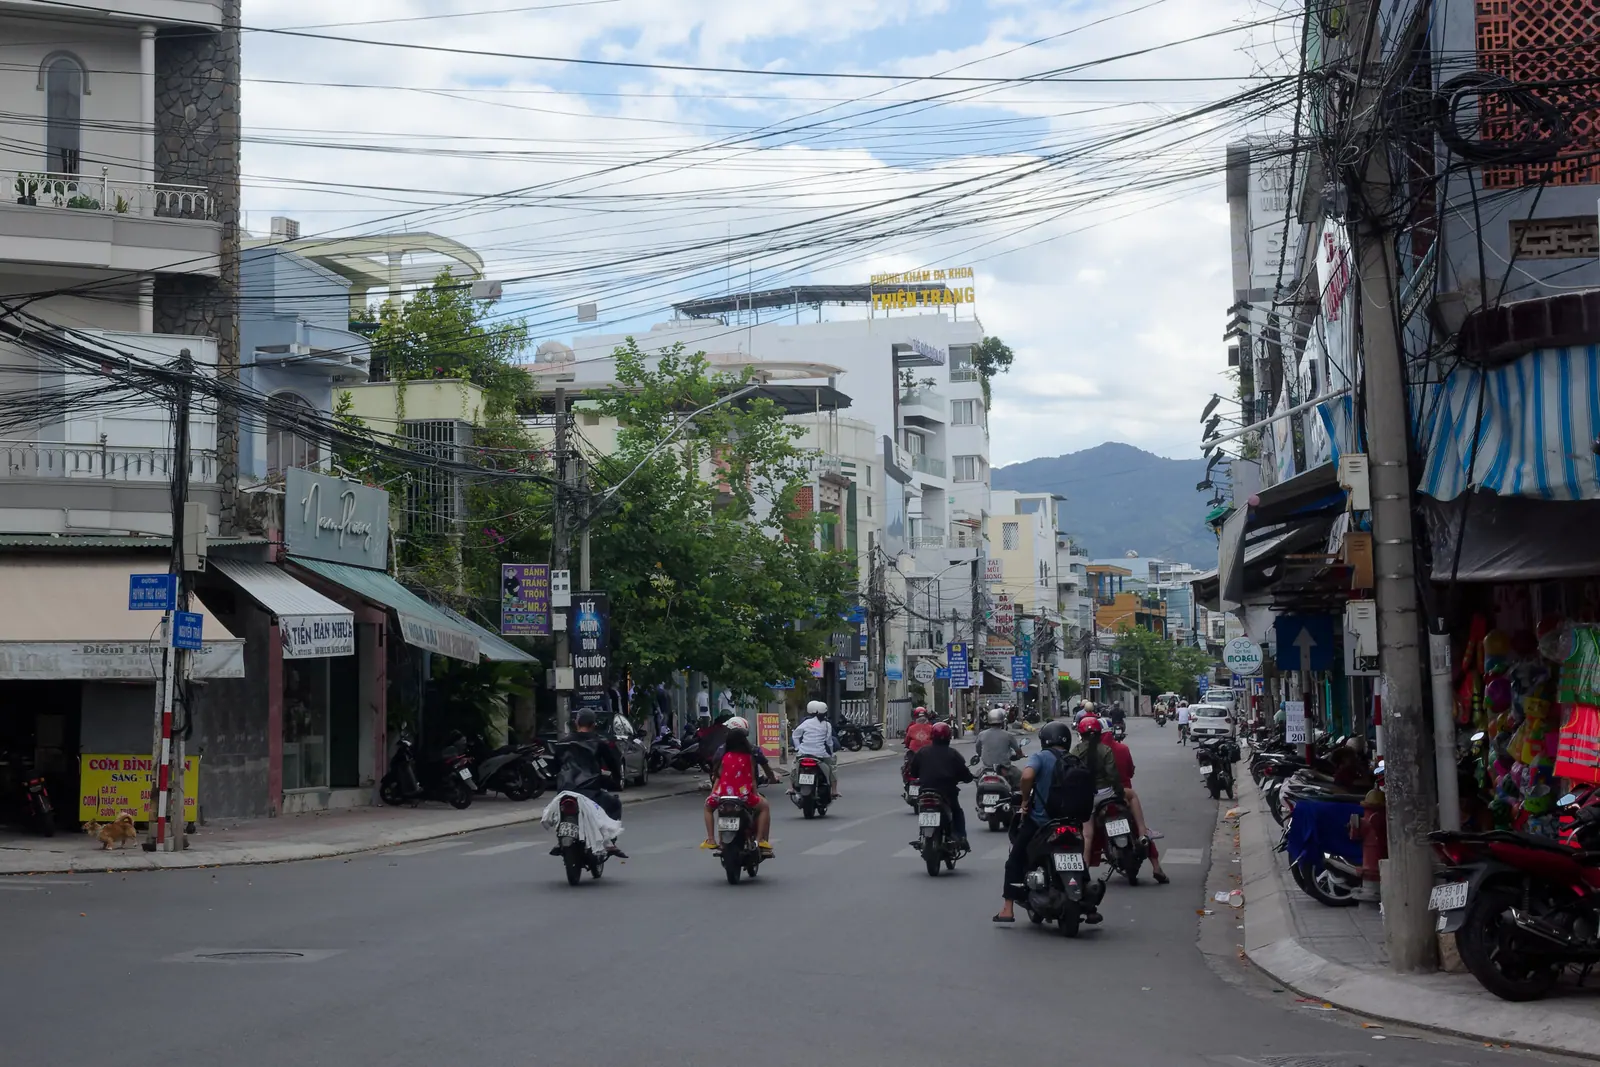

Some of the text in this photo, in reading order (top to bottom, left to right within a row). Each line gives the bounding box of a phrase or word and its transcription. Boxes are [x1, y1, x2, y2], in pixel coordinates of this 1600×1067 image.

[871, 267, 974, 285] PHÒNG KHÁM ĐA KHOA
[872, 287, 975, 311] THIỆN TRANG
[523, 566, 545, 576] BÁNH
[521, 577, 548, 587] TRÁNG
[523, 589, 545, 600] TRỘN
[580, 598, 596, 614] TIẾT
[291, 617, 312, 645] TIẾN
[313, 618, 330, 640] HÀN
[1227, 654, 1260, 663] MORELL
[89, 758, 120, 771] CƠM
[112, 773, 138, 782] SÁNG
[83, 795, 97, 806] CƠM
